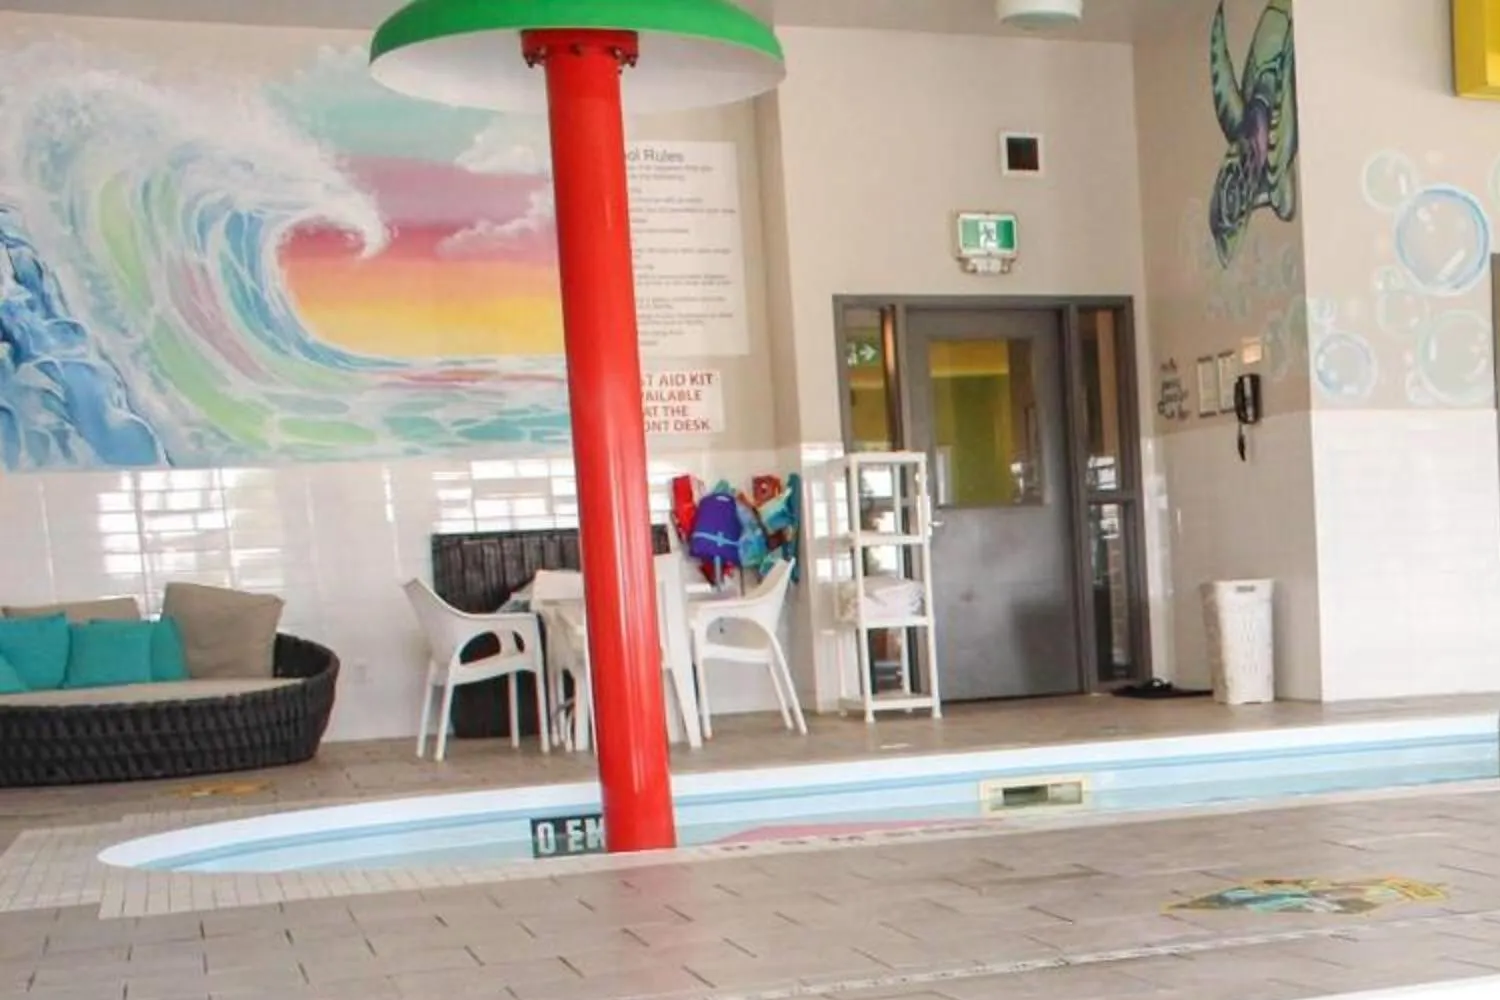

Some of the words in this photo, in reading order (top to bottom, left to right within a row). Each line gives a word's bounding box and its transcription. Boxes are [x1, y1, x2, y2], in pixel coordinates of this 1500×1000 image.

[643, 149, 685, 162] Rules
[659, 373, 686, 386] AID
[689, 372, 713, 386] KIT
[661, 405, 688, 417] THE
[673, 418, 712, 432] DESK
